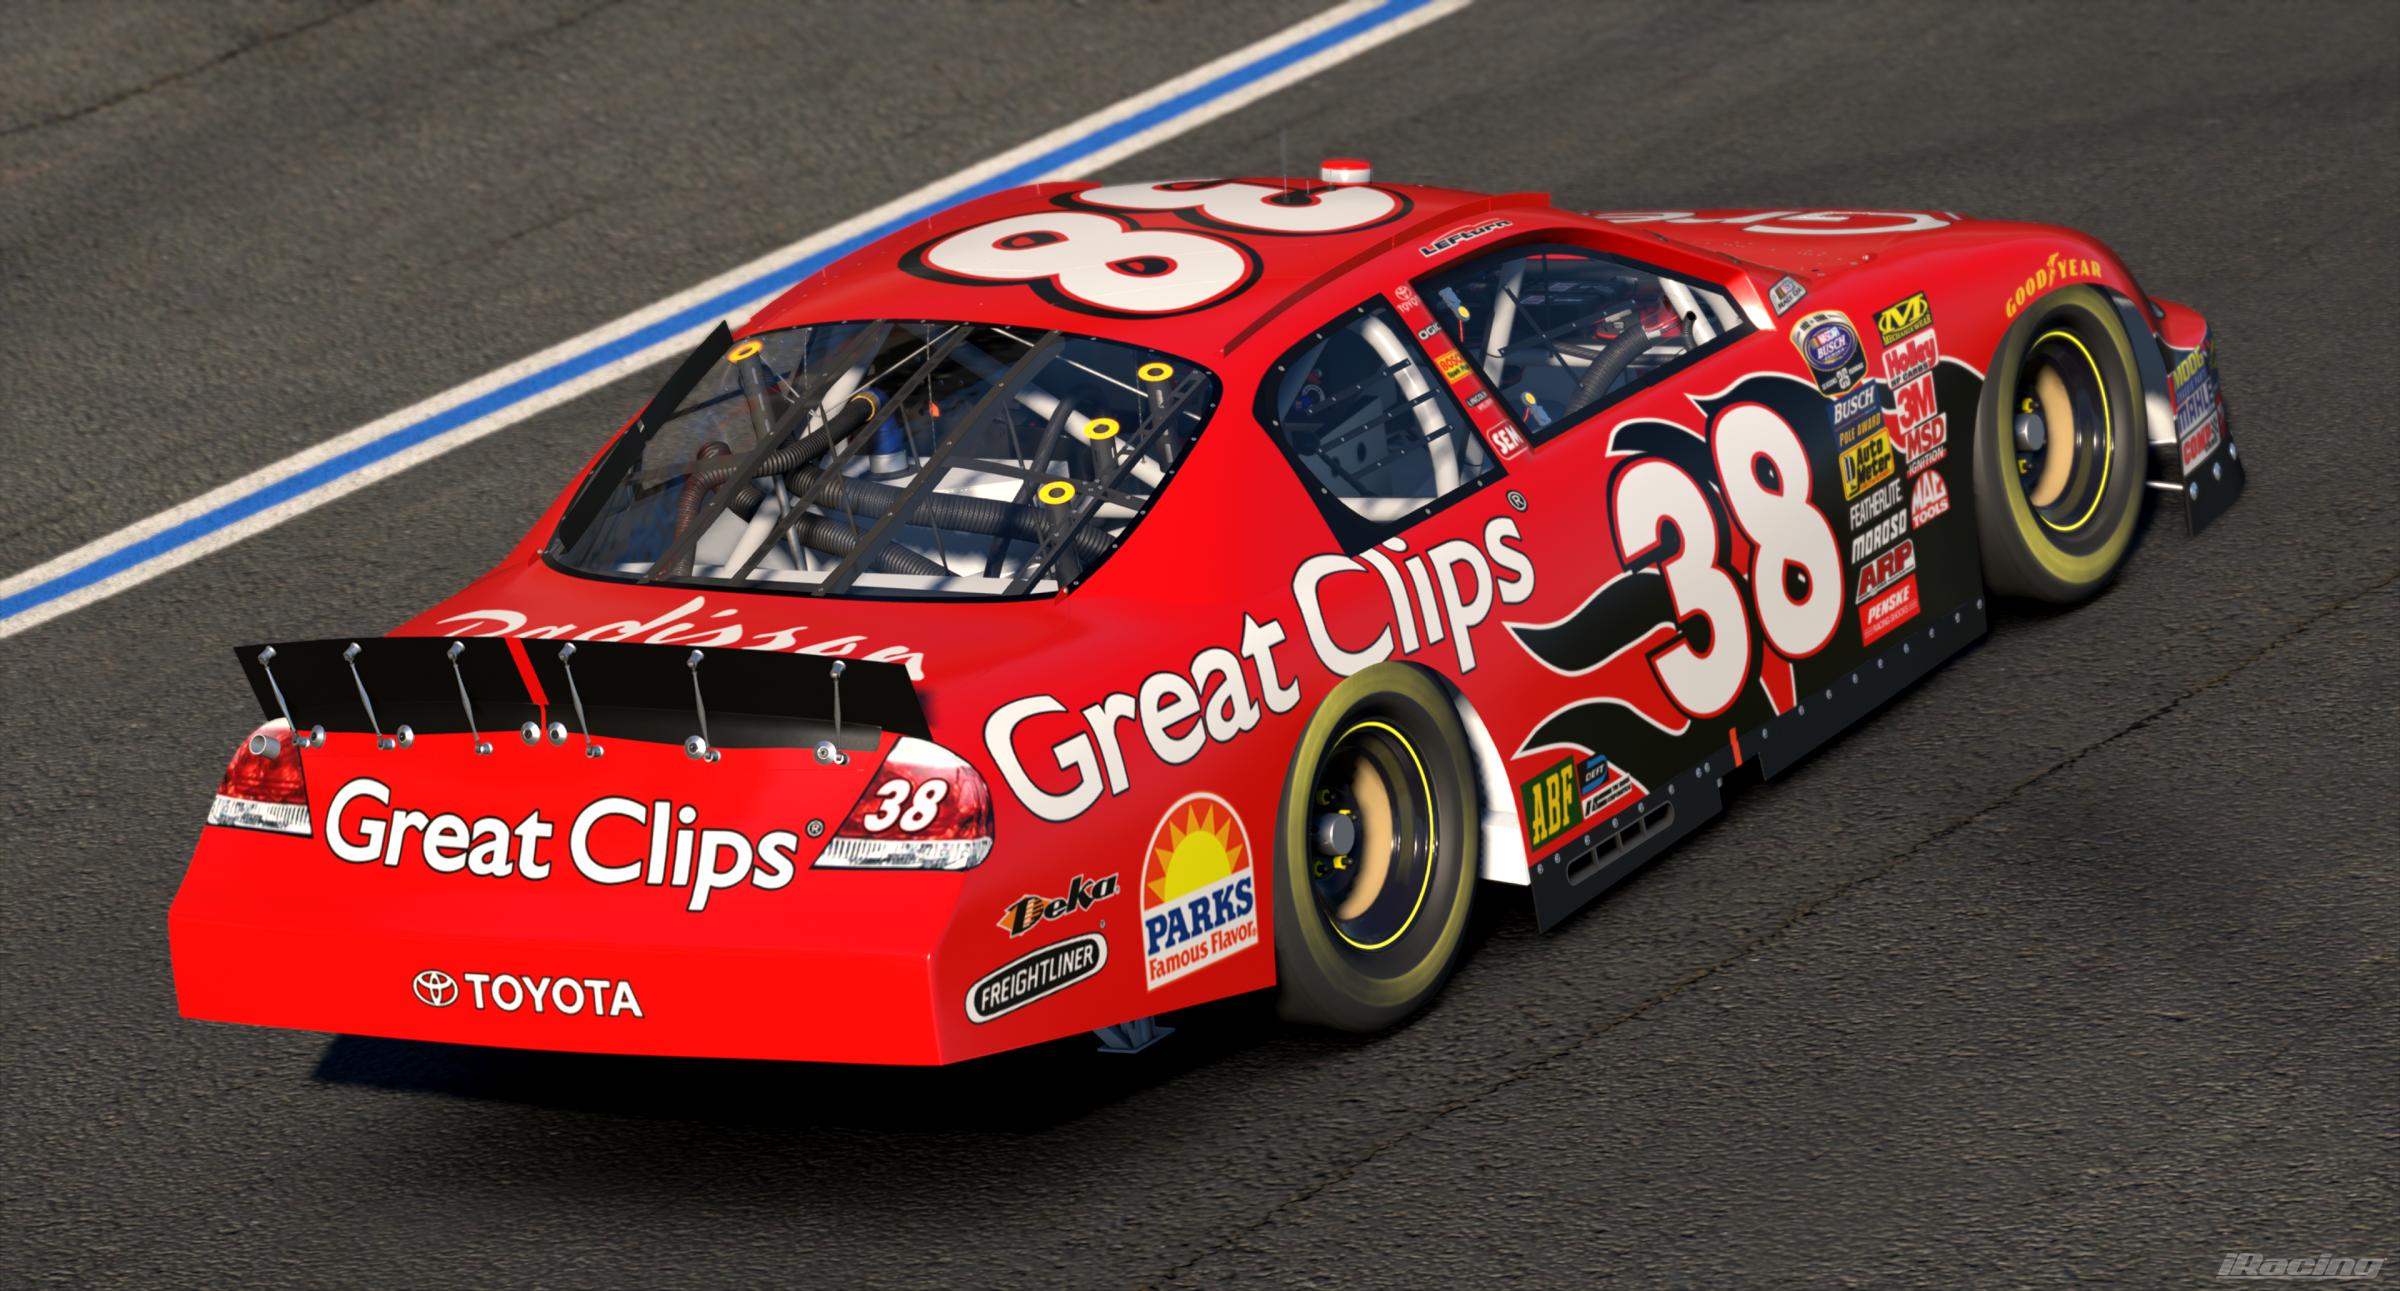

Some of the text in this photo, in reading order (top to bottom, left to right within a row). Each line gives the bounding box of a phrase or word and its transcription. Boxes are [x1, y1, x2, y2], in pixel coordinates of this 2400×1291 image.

[912, 178, 1402, 315] 38
[1397, 295, 1419, 313] TOYO
[1440, 354, 1464, 371] BOSC
[1817, 334, 1846, 360] BUSCH
[1885, 337, 1936, 379] Holley
[1834, 385, 1875, 425] BUSCH
[1897, 375, 1936, 429] 3M
[1491, 424, 1524, 455] SEM
[1839, 412, 1881, 448] POLE AWARD
[1857, 437, 1883, 464] Auto
[1905, 415, 1945, 462] MSD
[1857, 452, 1891, 485] Meter
[1912, 470, 1947, 514] MAC
[1850, 478, 1903, 531] FEATHERLITE
[1913, 499, 1949, 528] TOOLS
[1613, 400, 1845, 719] 38
[1851, 508, 1907, 564] MOROSO
[1858, 541, 1912, 597] ARP
[1867, 585, 1910, 624] PENSKE
[982, 515, 1535, 823] Great Clips
[862, 778, 949, 833] 38
[1532, 763, 1573, 846] ABF
[325, 777, 800, 912] Great Clips
[1003, 873, 1119, 938] Deka
[1145, 877, 1254, 956] PARKS
[981, 944, 1094, 1012] FREIGHTLINER
[1149, 940, 1209, 981] Famous
[464, 971, 645, 1019] TOYOTA
